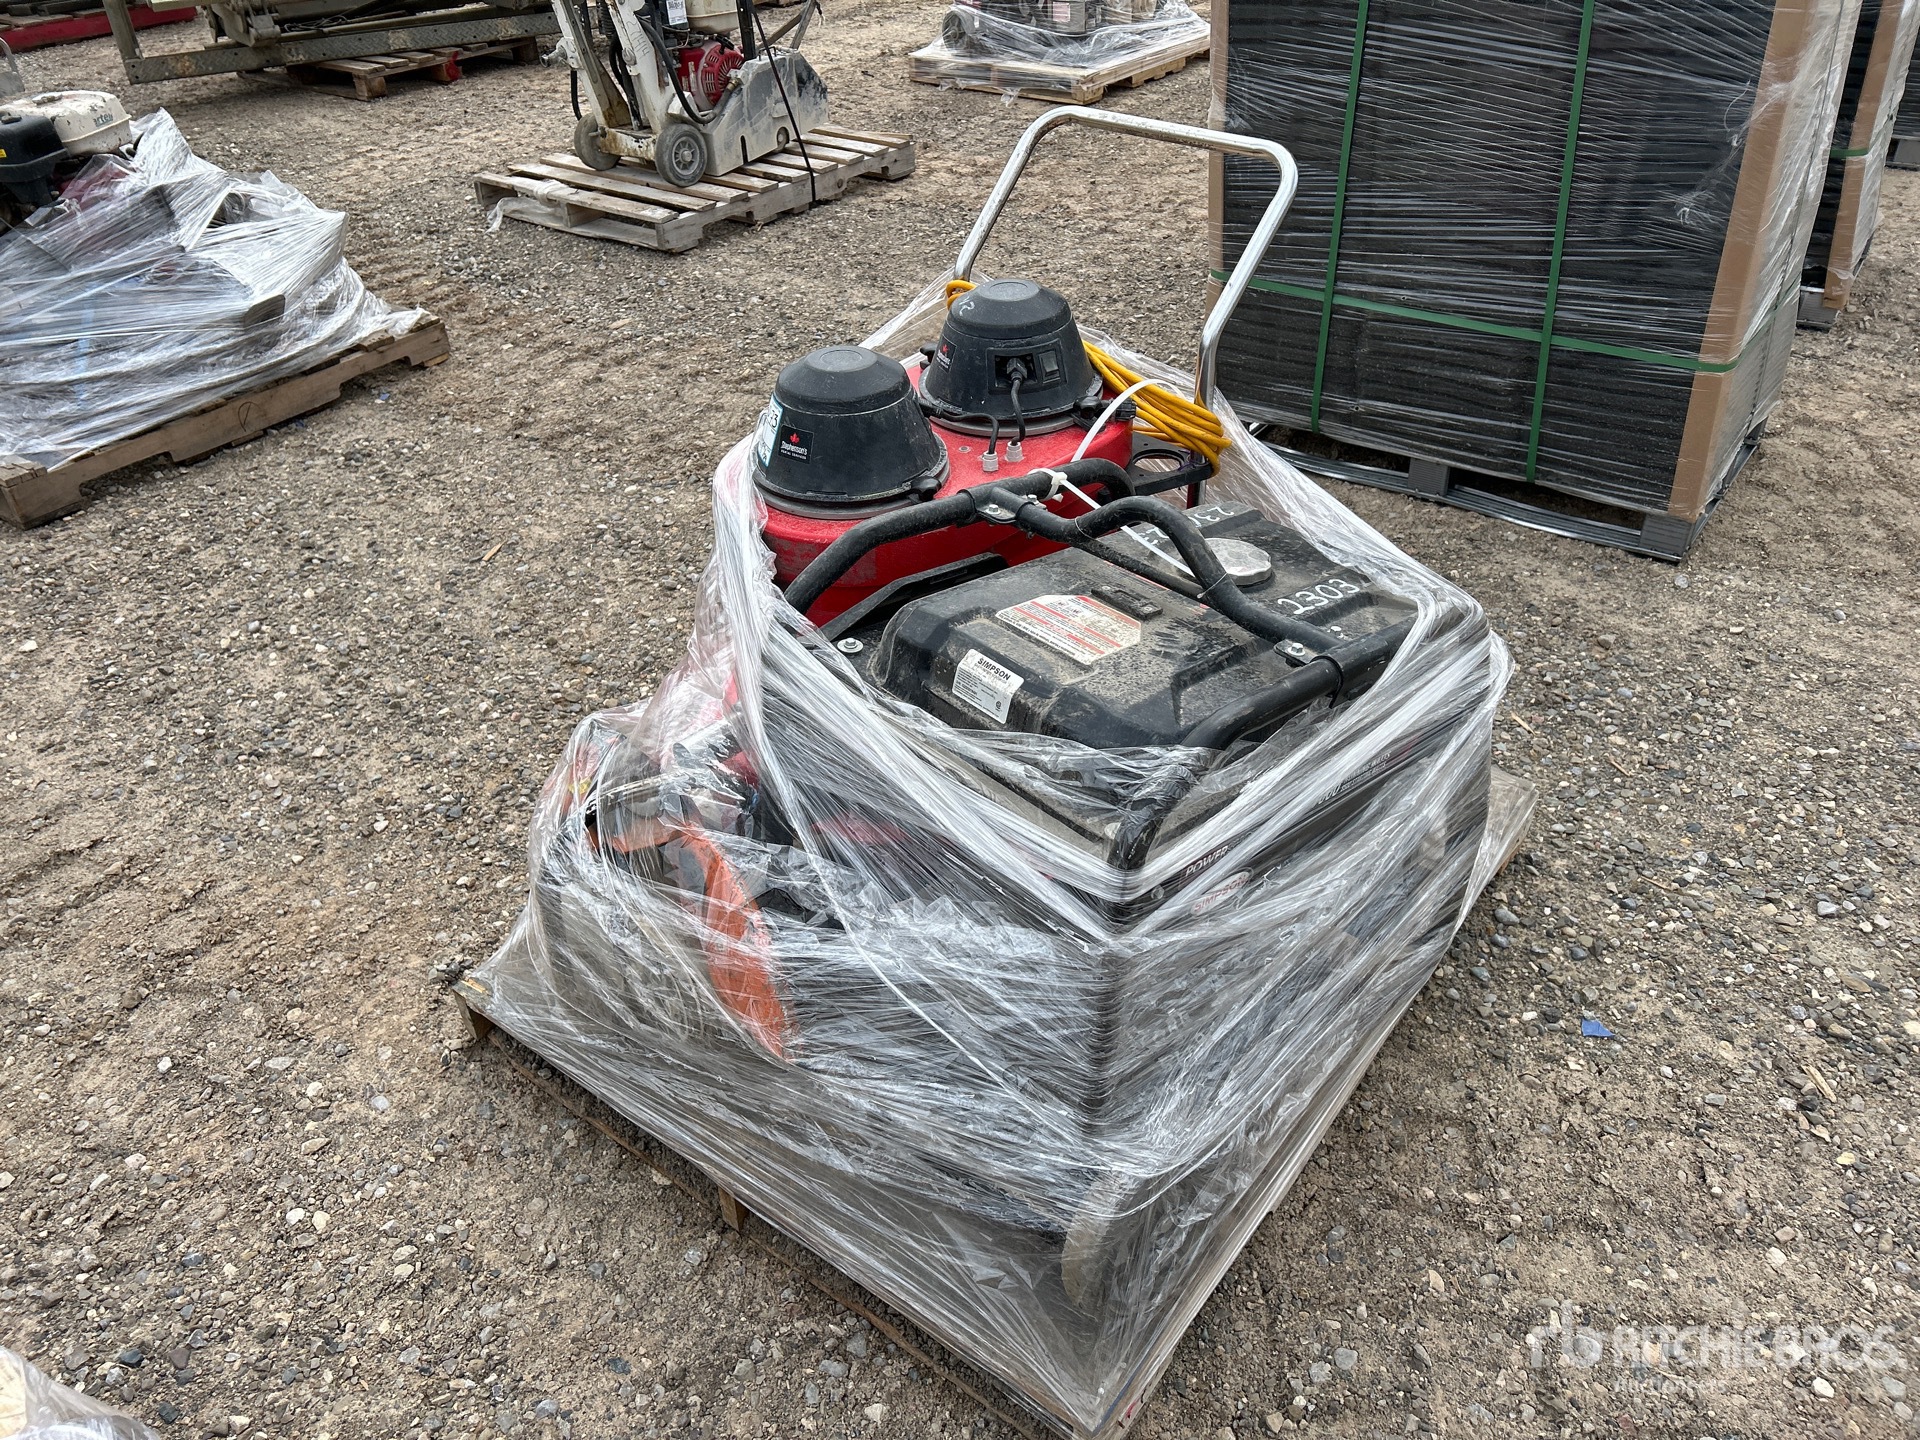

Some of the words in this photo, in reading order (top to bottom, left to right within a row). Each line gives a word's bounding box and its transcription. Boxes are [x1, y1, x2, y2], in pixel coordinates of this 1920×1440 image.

[1277, 578, 1360, 615] 2303
[977, 657, 1011, 681] SIMPSON
[1193, 872, 1249, 914] SIMPSON
